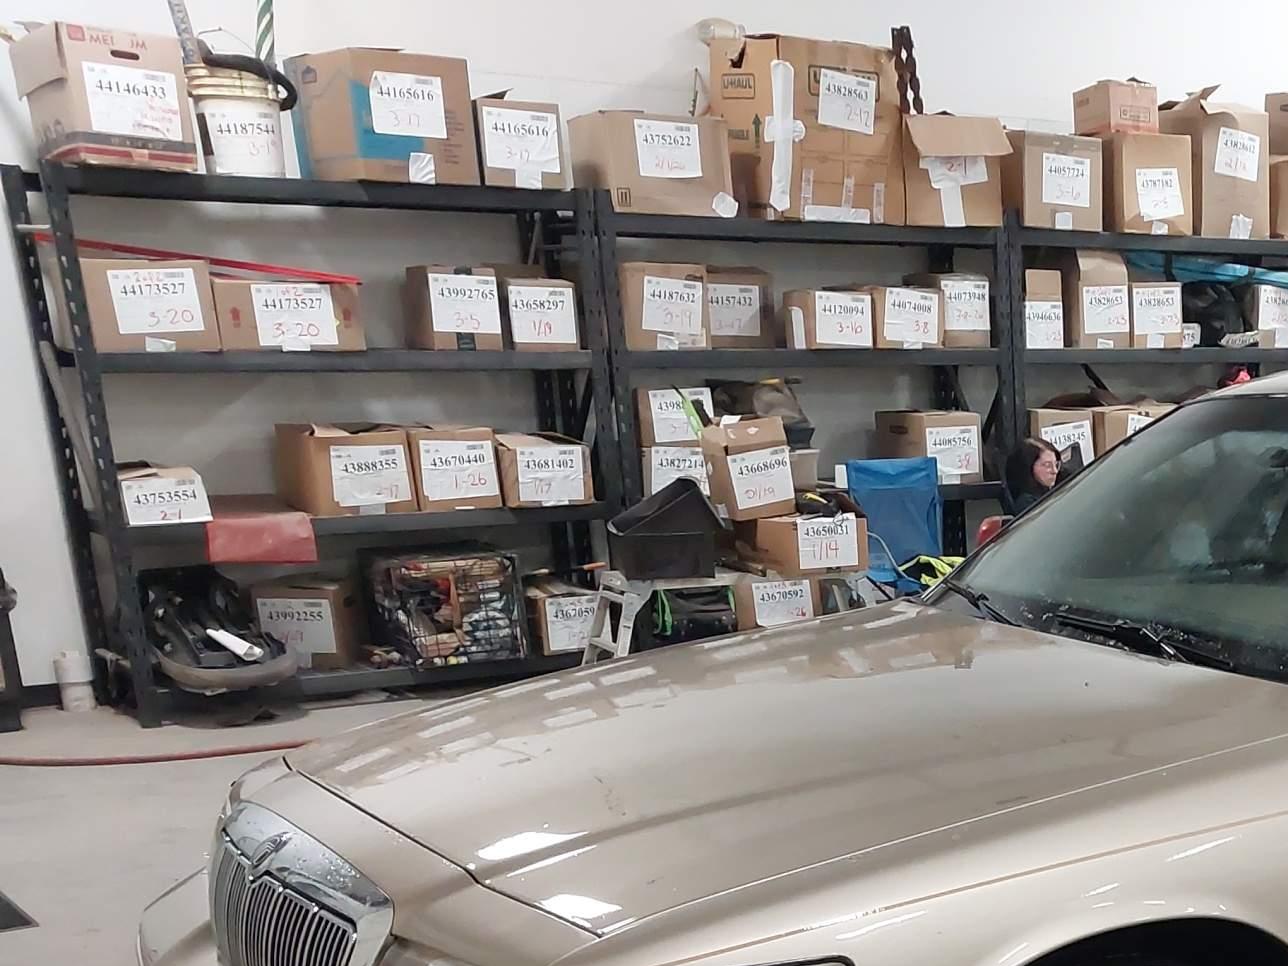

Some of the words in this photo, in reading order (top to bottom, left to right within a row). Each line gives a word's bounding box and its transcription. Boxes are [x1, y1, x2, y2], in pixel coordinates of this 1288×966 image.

[95, 79, 167, 100] 44146433
[376, 83, 434, 101] 44165616
[825, 81, 869, 101] 43828563
[216, 122, 275, 135] 44187544
[491, 120, 549, 138] 44165616
[642, 133, 692, 146] 43752622
[1048, 165, 1085, 178] 44057724
[120, 281, 185, 297] 44173527
[437, 286, 496, 300] 43992765
[649, 287, 696, 304] 44187632
[709, 295, 753, 307] 44157432
[946, 291, 987, 302] 44073948
[261, 297, 323, 311] 44173527
[511, 299, 565, 312] 43658297
[821, 303, 864, 317] 44120094
[890, 298, 932, 314] 44074008
[340, 458, 398, 474] 43888355
[429, 452, 486, 469] 43670440
[524, 458, 575, 470] 43681402
[657, 456, 705, 470] 43827214
[736, 456, 788, 478] 43668696
[132, 487, 198, 506] 43753554
[803, 522, 850, 537] 43650031
[759, 588, 805, 603] 43670592
[266, 610, 324, 622] 43992255
[552, 606, 596, 620] 4367059
